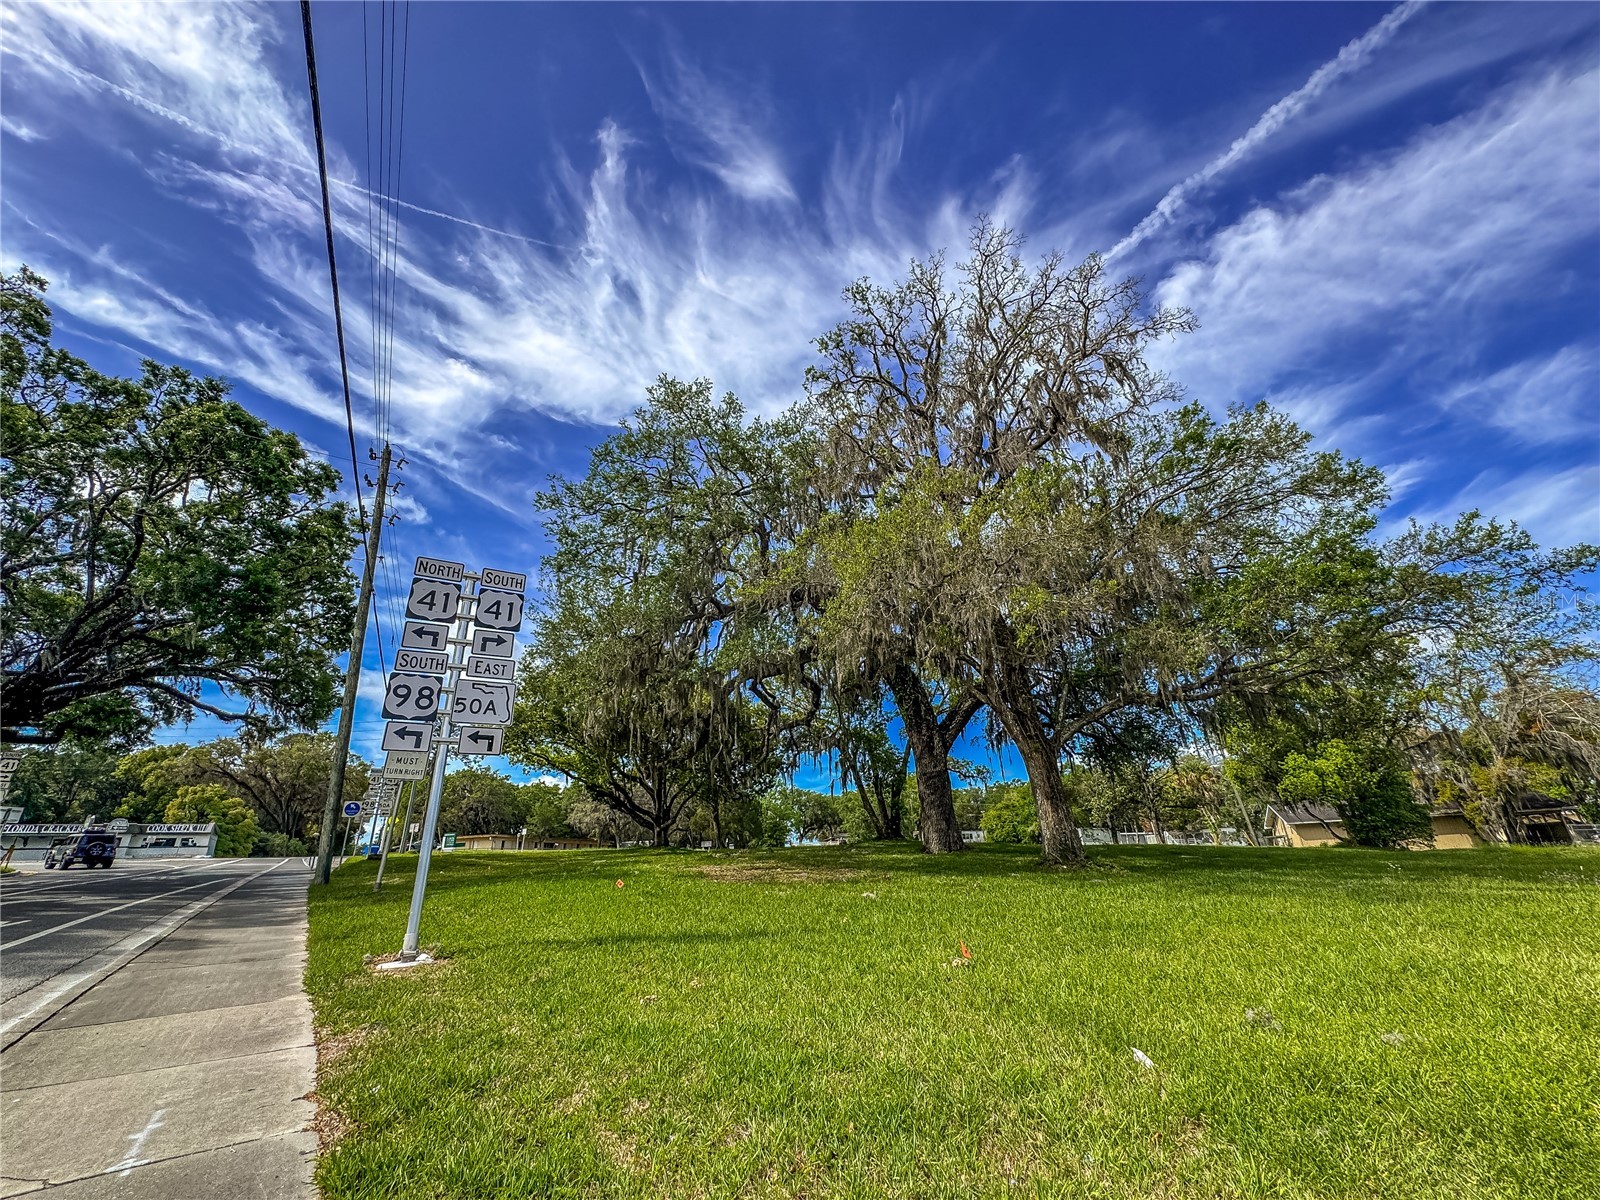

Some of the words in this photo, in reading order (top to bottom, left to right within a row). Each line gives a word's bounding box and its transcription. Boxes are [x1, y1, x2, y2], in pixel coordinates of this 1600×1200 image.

[418, 561, 461, 579] NORTH
[485, 572, 523, 590] SOUTH
[416, 589, 451, 613] 41
[483, 599, 515, 622] 41
[399, 653, 445, 671] SOUTH
[474, 660, 507, 677] EAST
[392, 683, 434, 711] 98
[453, 697, 497, 716] 50A
[396, 757, 419, 765] MUST
[2, 824, 39, 833] FLORIDA
[40, 824, 83, 833] CRACKER
